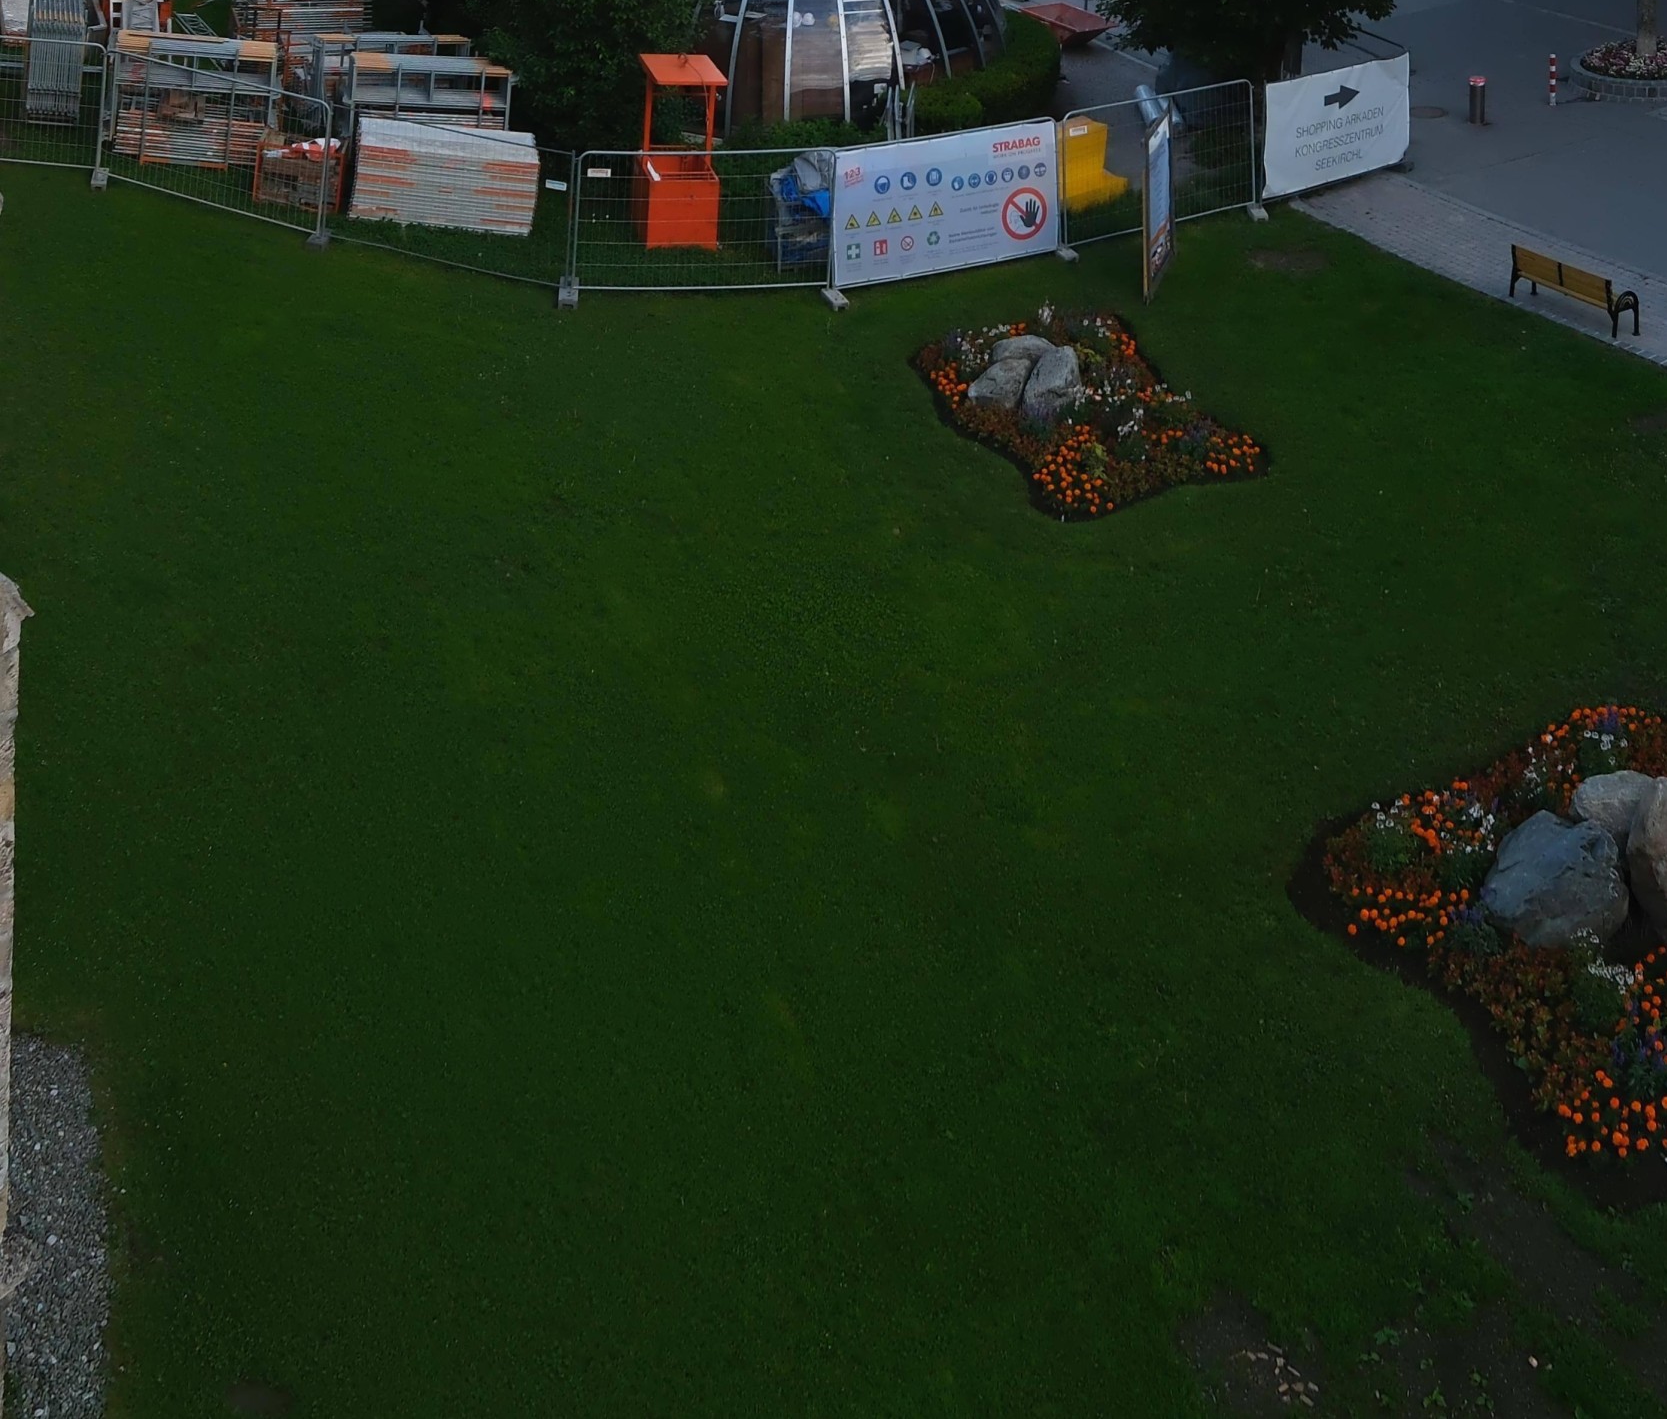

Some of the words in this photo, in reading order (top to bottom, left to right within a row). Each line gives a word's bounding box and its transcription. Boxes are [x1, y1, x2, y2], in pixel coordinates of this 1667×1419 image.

[1296, 119, 1343, 139] SHOPPING
[1344, 106, 1385, 127] ARKADEN
[992, 137, 1041, 153] STRABAG
[1295, 124, 1384, 158] KONGRESSZENTRUM
[1315, 148, 1363, 171] SEEKIRCHL
